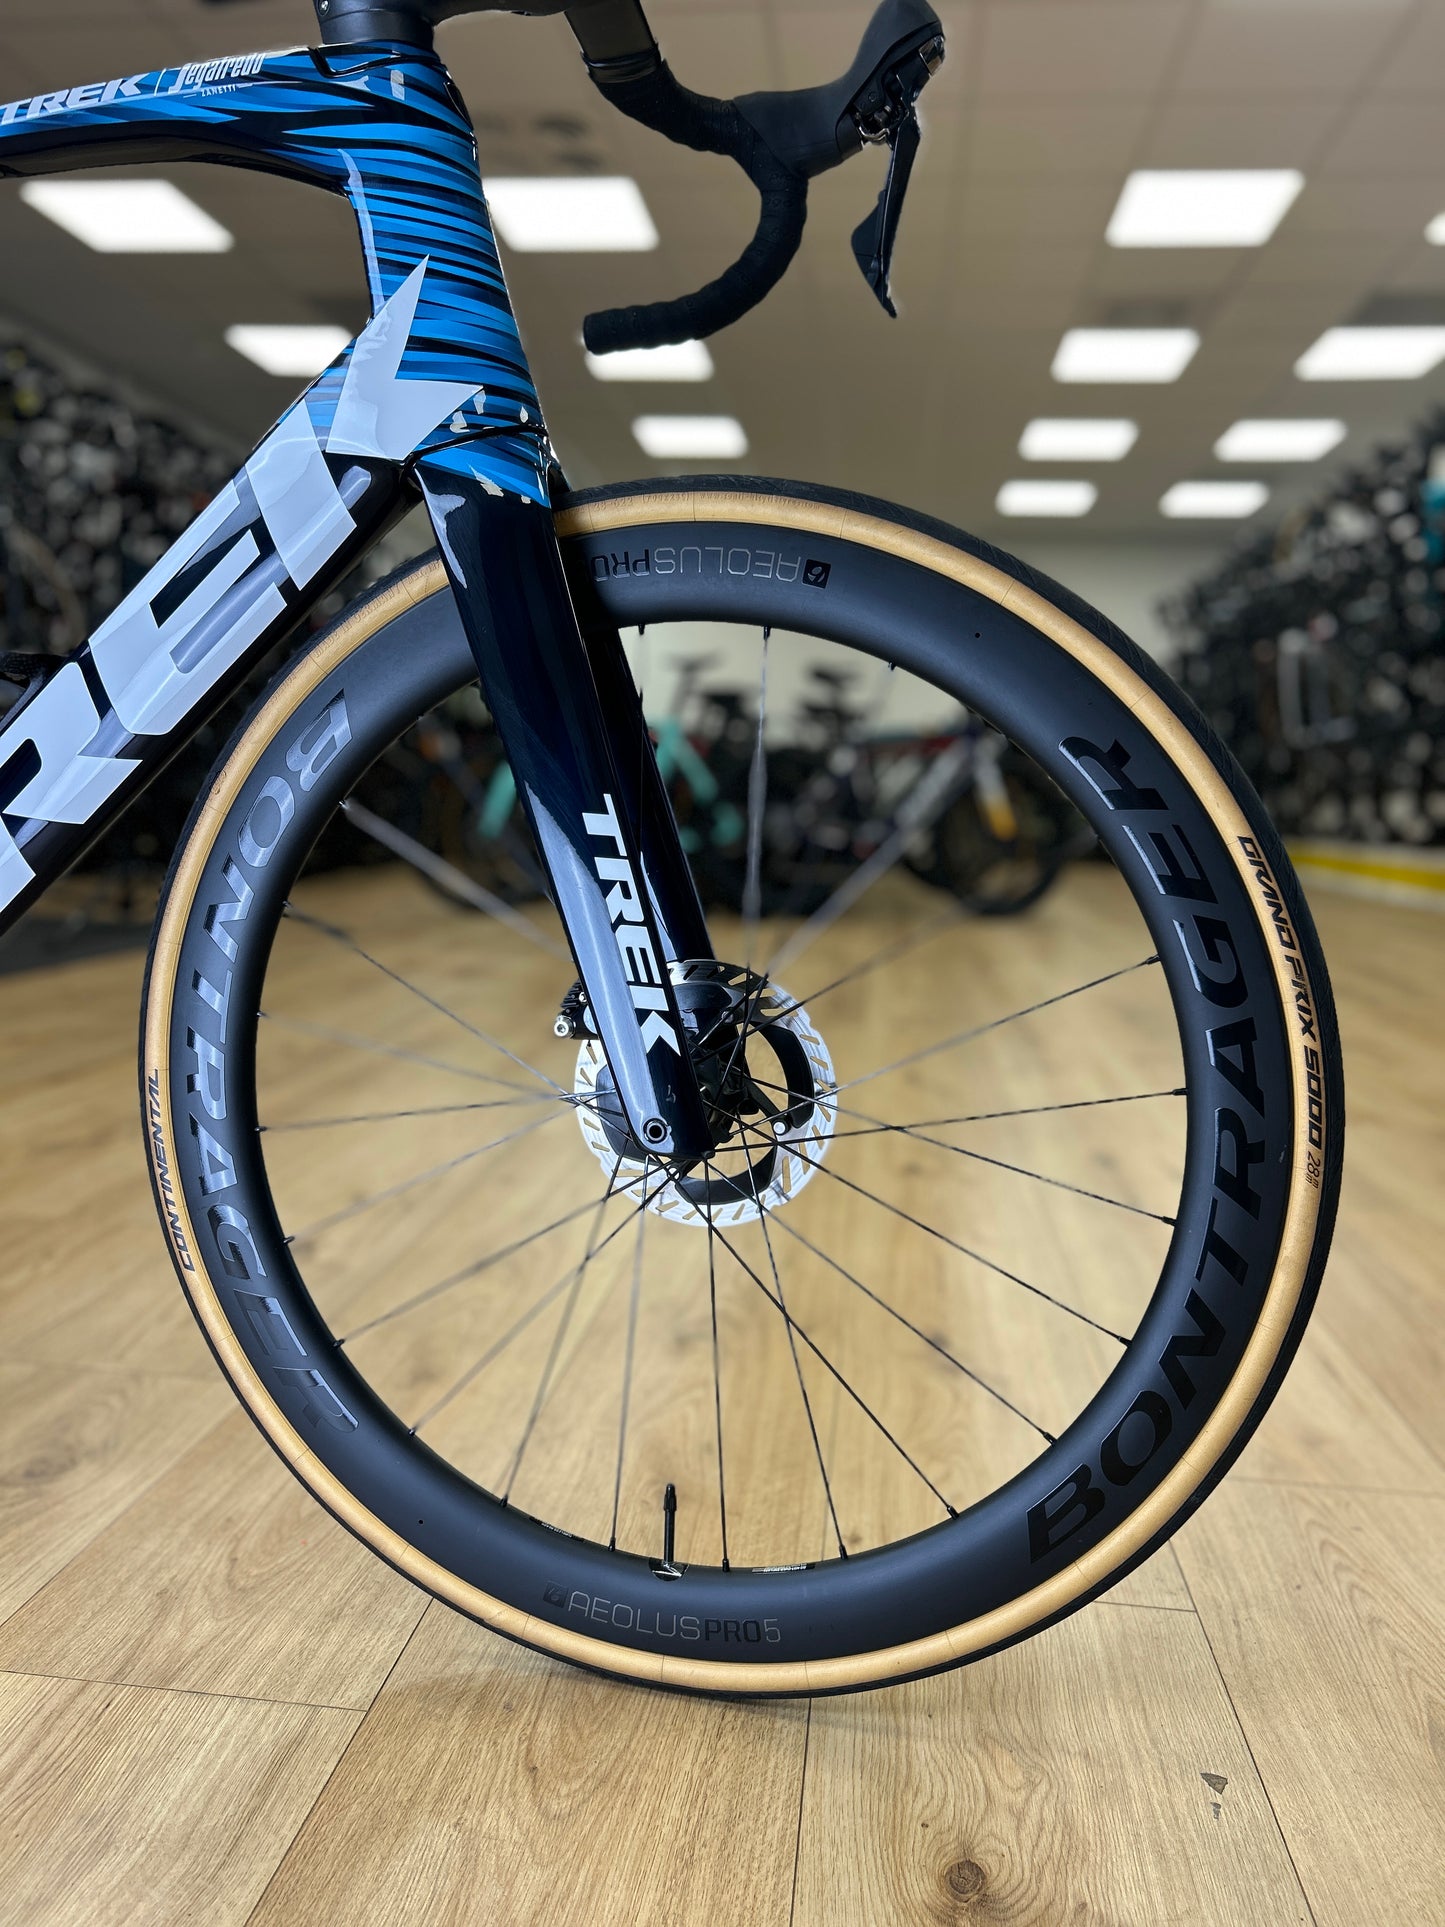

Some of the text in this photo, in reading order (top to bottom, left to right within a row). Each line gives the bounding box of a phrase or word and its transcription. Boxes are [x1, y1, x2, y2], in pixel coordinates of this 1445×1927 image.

[0, 72, 151, 126] TREK
[201, 84, 237, 98] ZANETTI
[582, 793, 682, 1057] TREK
[1238, 835, 1299, 951] GRAND
[1284, 954, 1317, 1043] PRIX
[1303, 1045, 1327, 1150] 5000
[149, 1068, 196, 1272] CONTINENTAL
[186, 689, 360, 1433] BONTRAGER
[1026, 736, 1266, 1564] BONTRAGER
